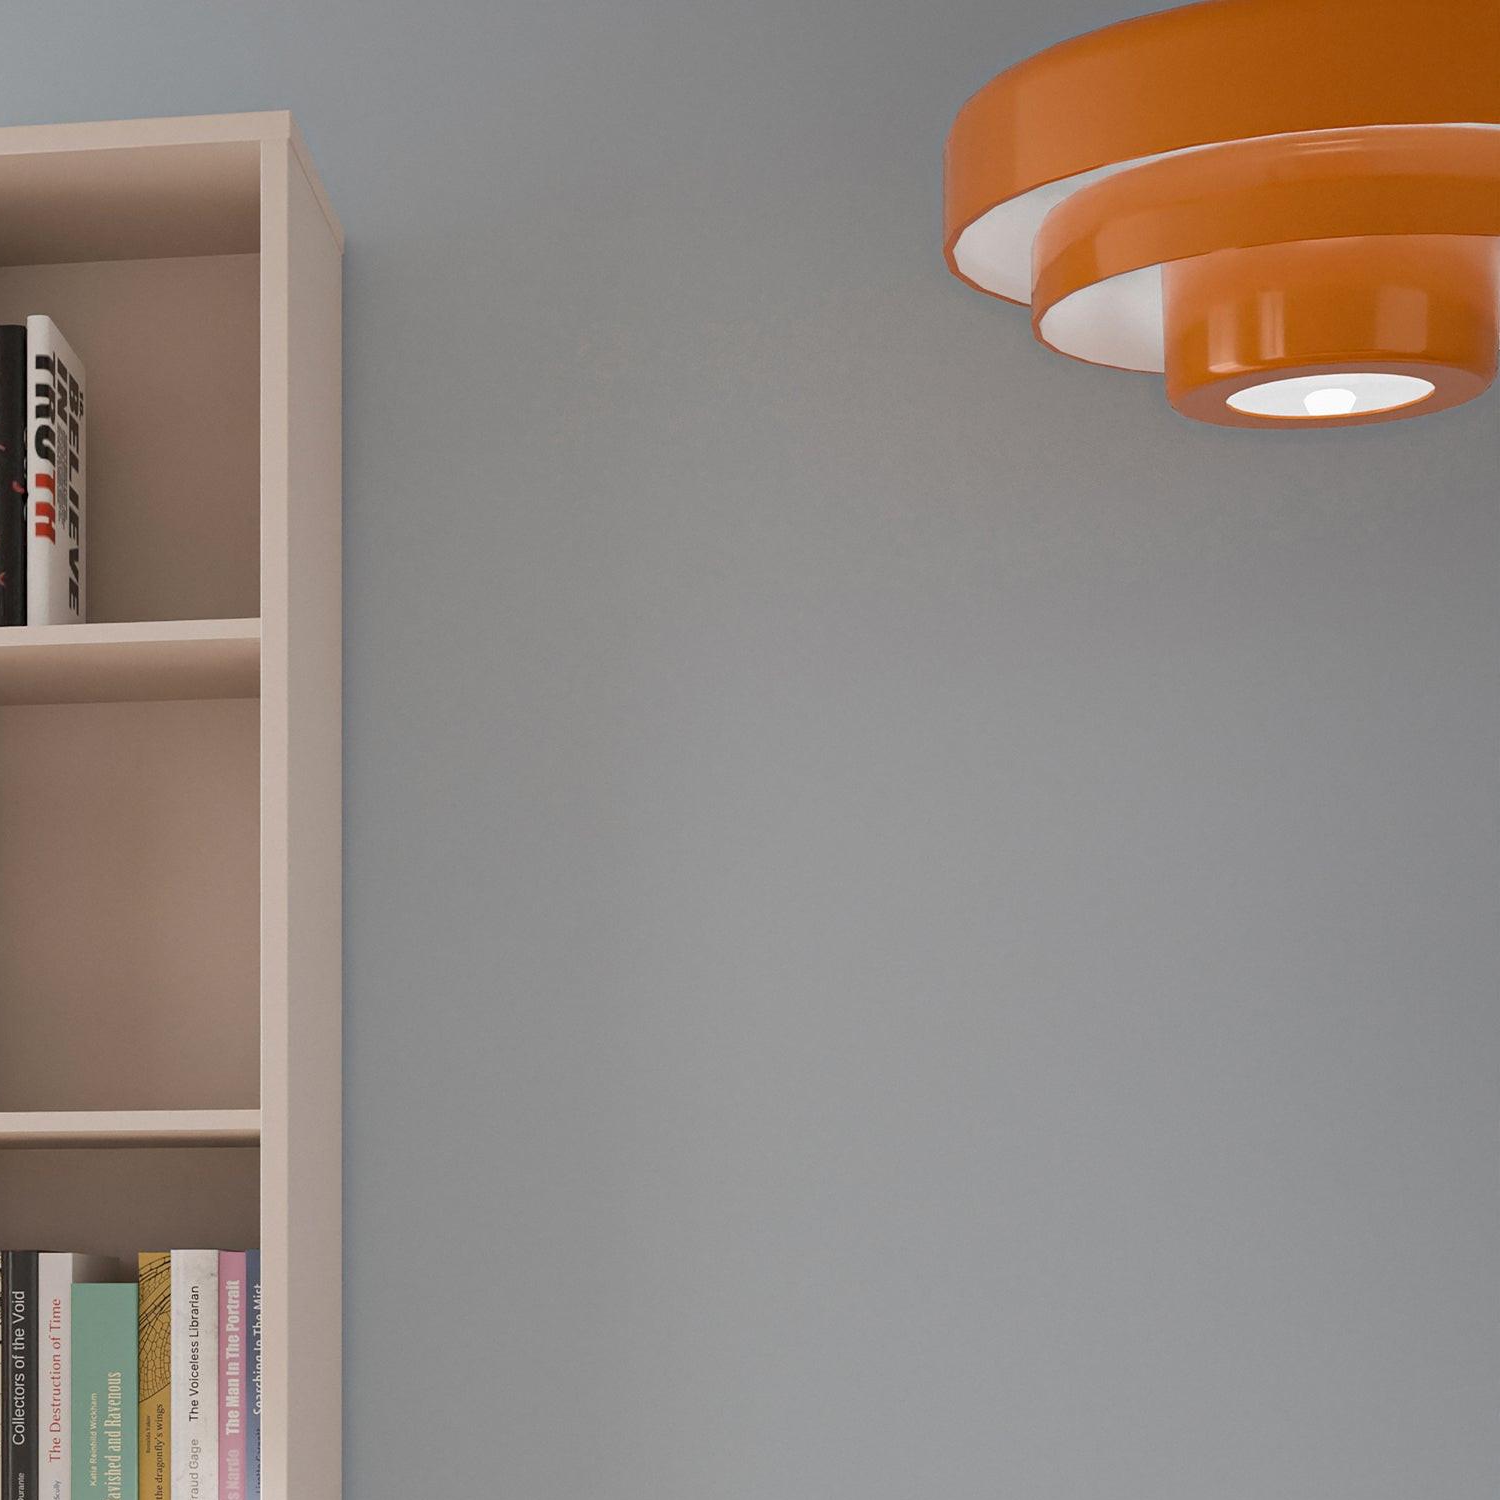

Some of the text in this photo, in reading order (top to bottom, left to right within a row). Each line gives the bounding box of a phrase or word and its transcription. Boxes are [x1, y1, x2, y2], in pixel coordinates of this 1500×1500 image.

[35, 351, 56, 544] TRUTH
[57, 358, 68, 426] IN
[69, 374, 79, 616] BELIEVE
[12, 1291, 25, 1445] Collectors of the Void
[49, 1299, 61, 1462] The Destruction of Time
[104, 1372, 121, 1427] Ravenous
[189, 1286, 198, 1421] The Voiceless Librarian
[226, 1280, 240, 1435] The Man In The Portrait
[105, 1431, 121, 1451] and
[189, 1439, 201, 1469] Gage
